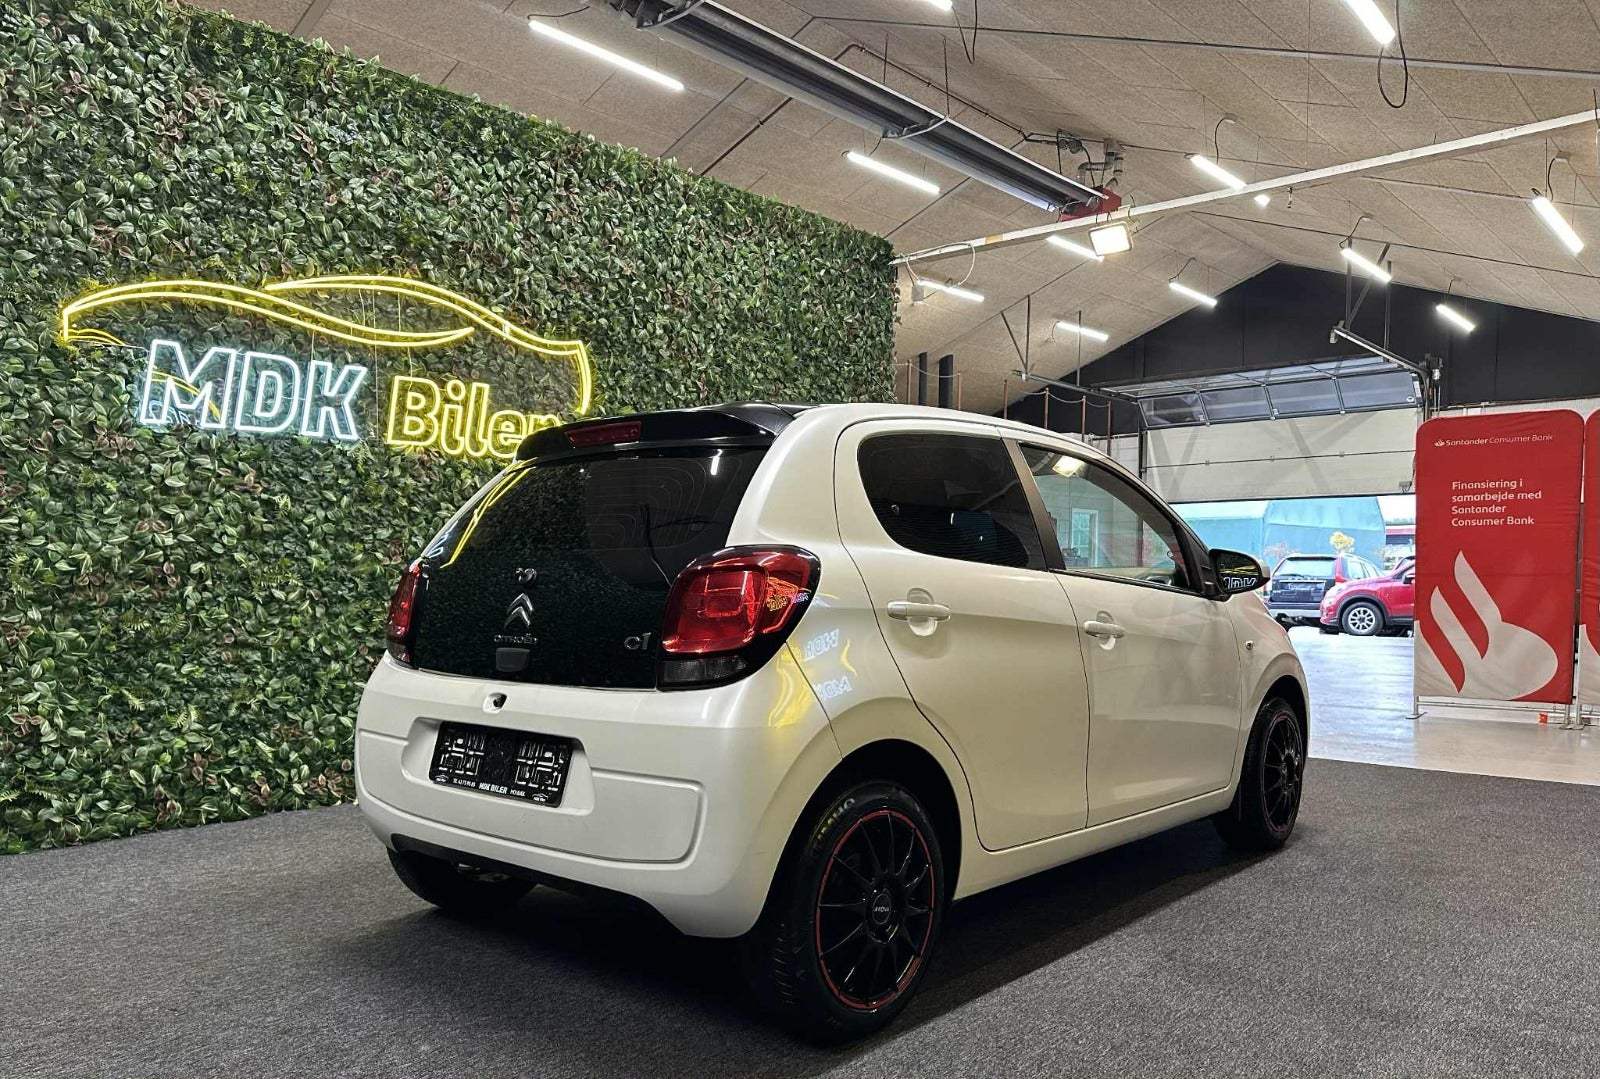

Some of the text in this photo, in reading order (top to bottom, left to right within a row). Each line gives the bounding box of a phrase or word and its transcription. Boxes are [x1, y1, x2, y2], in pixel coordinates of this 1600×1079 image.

[139, 338, 368, 441] MDK
[1446, 434, 1553, 446] Santander Consumer Bank
[1452, 478, 1523, 490] Finansiering i
[1451, 490, 1542, 502] samarbejde med
[1451, 505, 1507, 514] Santander
[1451, 516, 1535, 527] Consumer Bank
